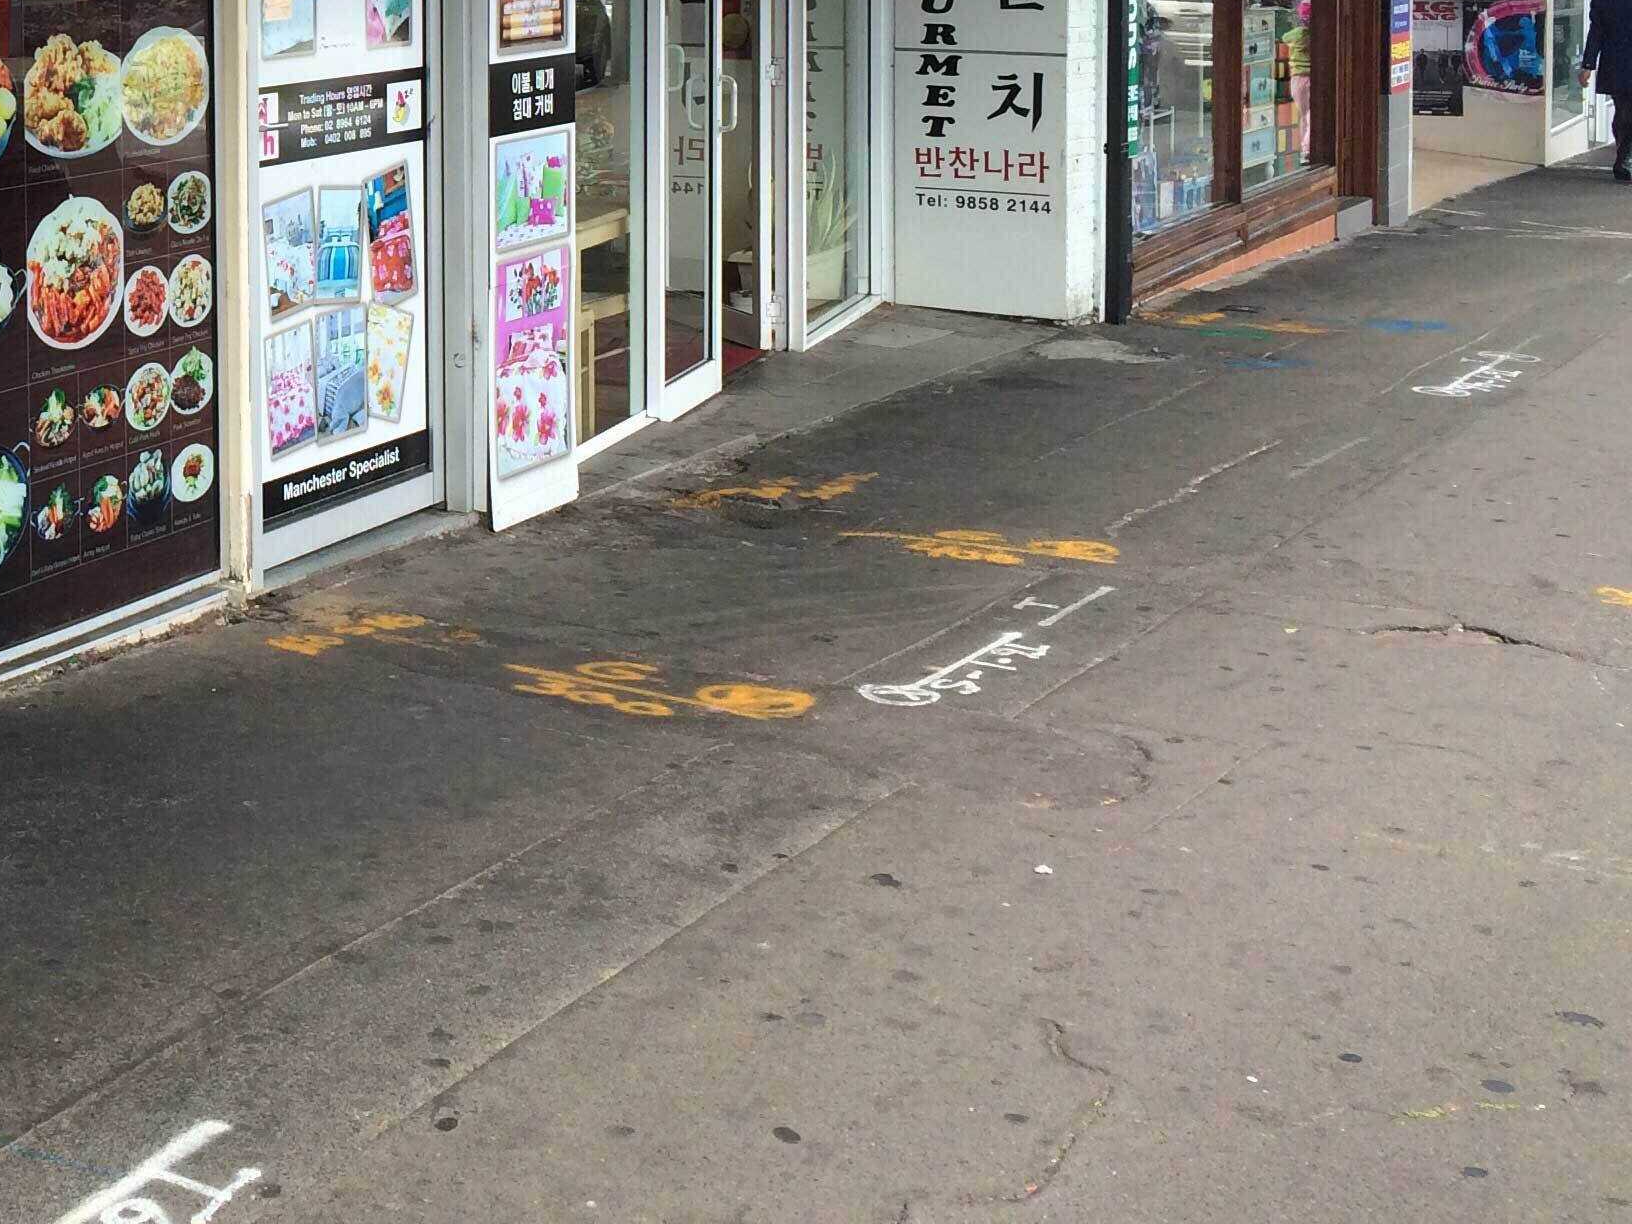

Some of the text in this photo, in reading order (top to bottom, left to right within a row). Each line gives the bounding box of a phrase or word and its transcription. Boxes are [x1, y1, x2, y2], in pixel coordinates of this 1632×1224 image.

[1413, 1, 1457, 14] IG
[535, 68, 555, 89] 베개
[299, 90, 325, 105] Trading
[326, 88, 345, 102] Hours
[513, 93, 554, 120] 침대 커버
[287, 109, 302, 122] Mon
[303, 109, 310, 120] to
[311, 107, 322, 119] Sat
[324, 119, 334, 132] 02
[355, 114, 371, 128] 6124
[915, 145, 1051, 184] 반찬나라
[916, 191, 1052, 216] Tel: 9858 2144
[283, 446, 400, 502] Manchester Specialist
